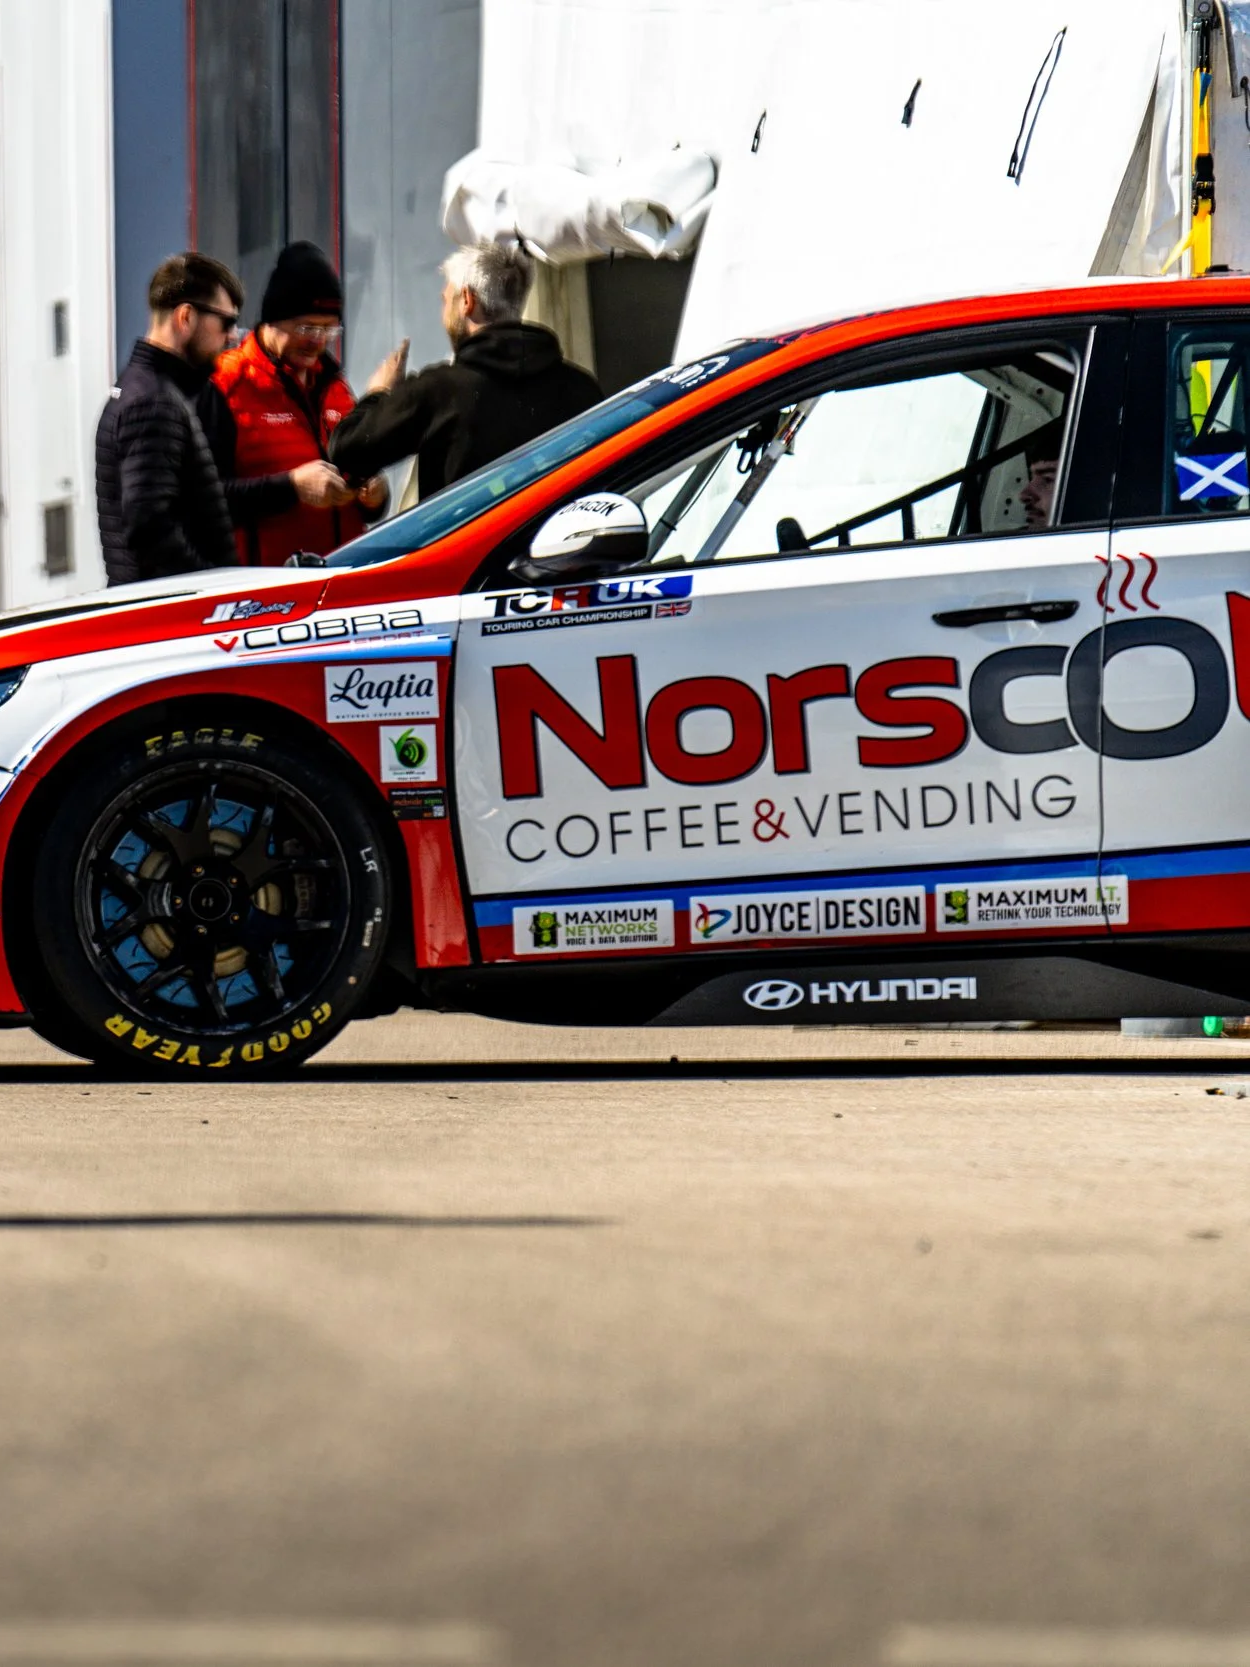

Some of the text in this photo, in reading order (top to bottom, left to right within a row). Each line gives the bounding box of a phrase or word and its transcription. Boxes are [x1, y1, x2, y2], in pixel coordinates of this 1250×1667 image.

[485, 578, 667, 618] TCR UK
[484, 607, 649, 634] TOURING CAR CHAMPIONSHIP
[330, 667, 434, 710] Laqtia
[977, 888, 1088, 908] MAXIMUM
[565, 907, 658, 925] MAXIMUM
[978, 903, 1122, 922] RETHINK YOUR TECHNOLOGY
[565, 921, 658, 938] NETWORKS
[566, 934, 658, 946] VOICE & DATA SOLUTIONS
[810, 976, 977, 1004] HYUNDAI
